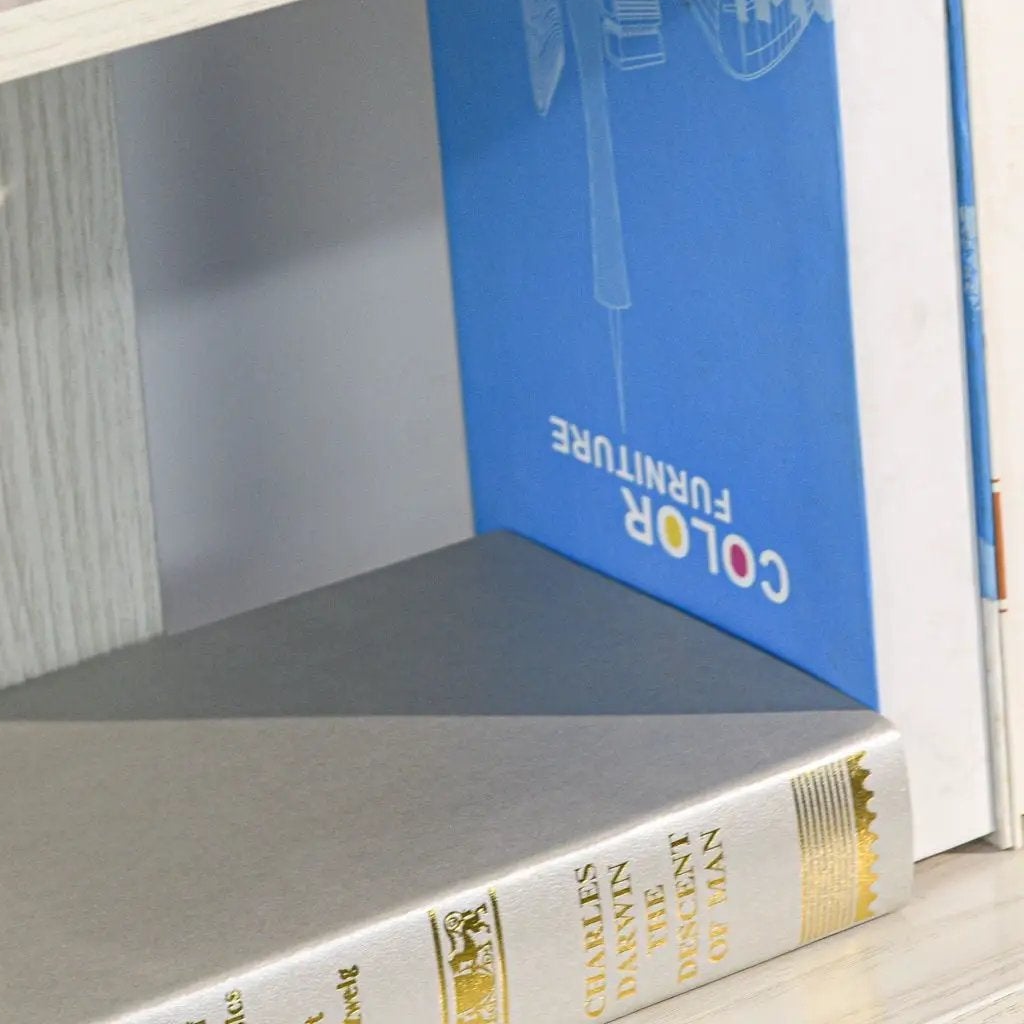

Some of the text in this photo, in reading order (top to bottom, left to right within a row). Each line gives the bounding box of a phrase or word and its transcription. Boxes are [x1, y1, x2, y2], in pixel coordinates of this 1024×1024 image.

[548, 414, 733, 525] FURNITURE
[620, 486, 791, 605] COLOR
[574, 862, 607, 1019] CHARLES
[607, 860, 639, 1000] DARWIN
[644, 884, 667, 956] THE
[667, 831, 700, 984] DESCENT
[700, 827, 728, 963] OF MAN
